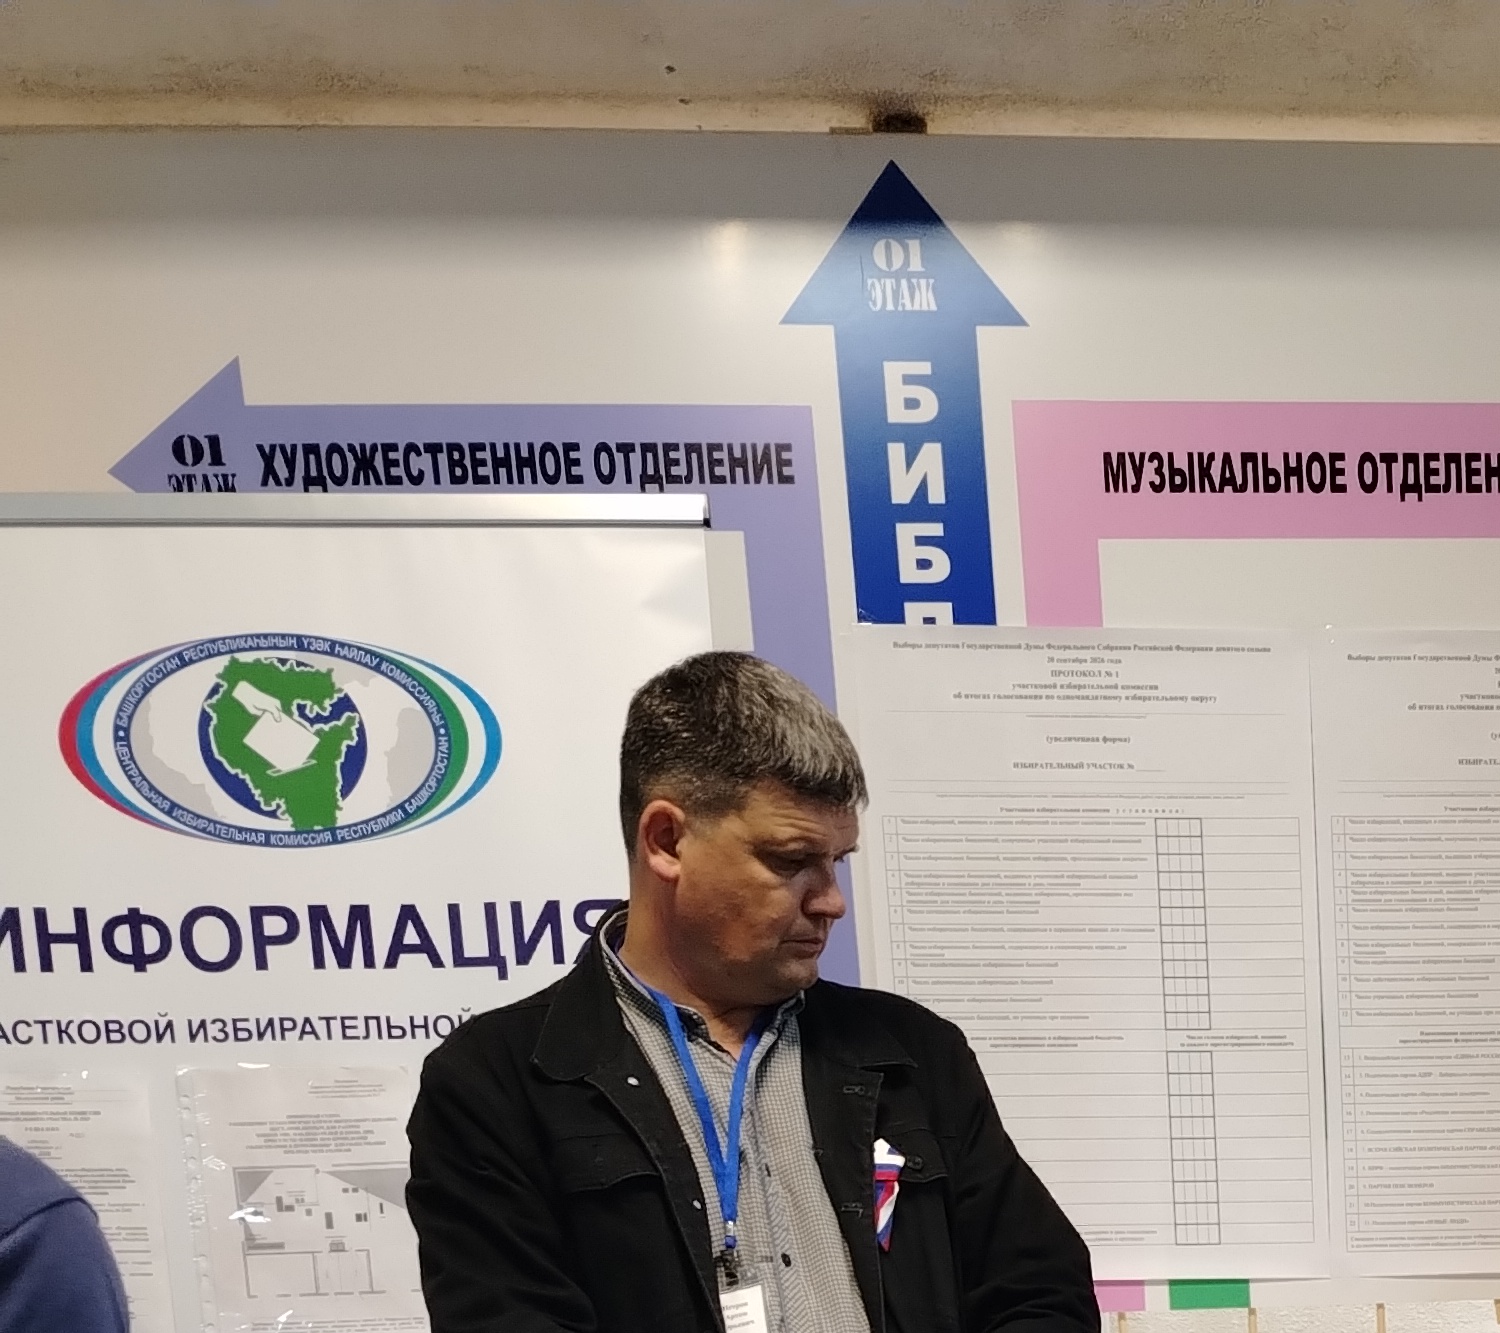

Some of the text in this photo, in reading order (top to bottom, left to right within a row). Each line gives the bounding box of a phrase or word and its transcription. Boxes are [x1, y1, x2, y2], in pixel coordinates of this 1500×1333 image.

[872, 238, 926, 272] 01
[867, 278, 938, 312] ЭТАЖ
[171, 434, 227, 467] 01
[256, 441, 796, 493] ХУДОЖЕСТВЕННОЕ ОТДЕЛЕНИЕ
[1102, 451, 1348, 494] МУЗЫКАЛЬНОЕ
[1050, 669, 1102, 678] ПРОТОКОЛ
[1086, 762, 1125, 770] УЧАСТОК
[116, 736, 449, 846] ЦЕНТРАЛЬНАЯ ИЗБИРАТЕЛЬНАЯ КОМИССИЯ РЕСПУБЛИКИ БАШКОРТОСТАН
